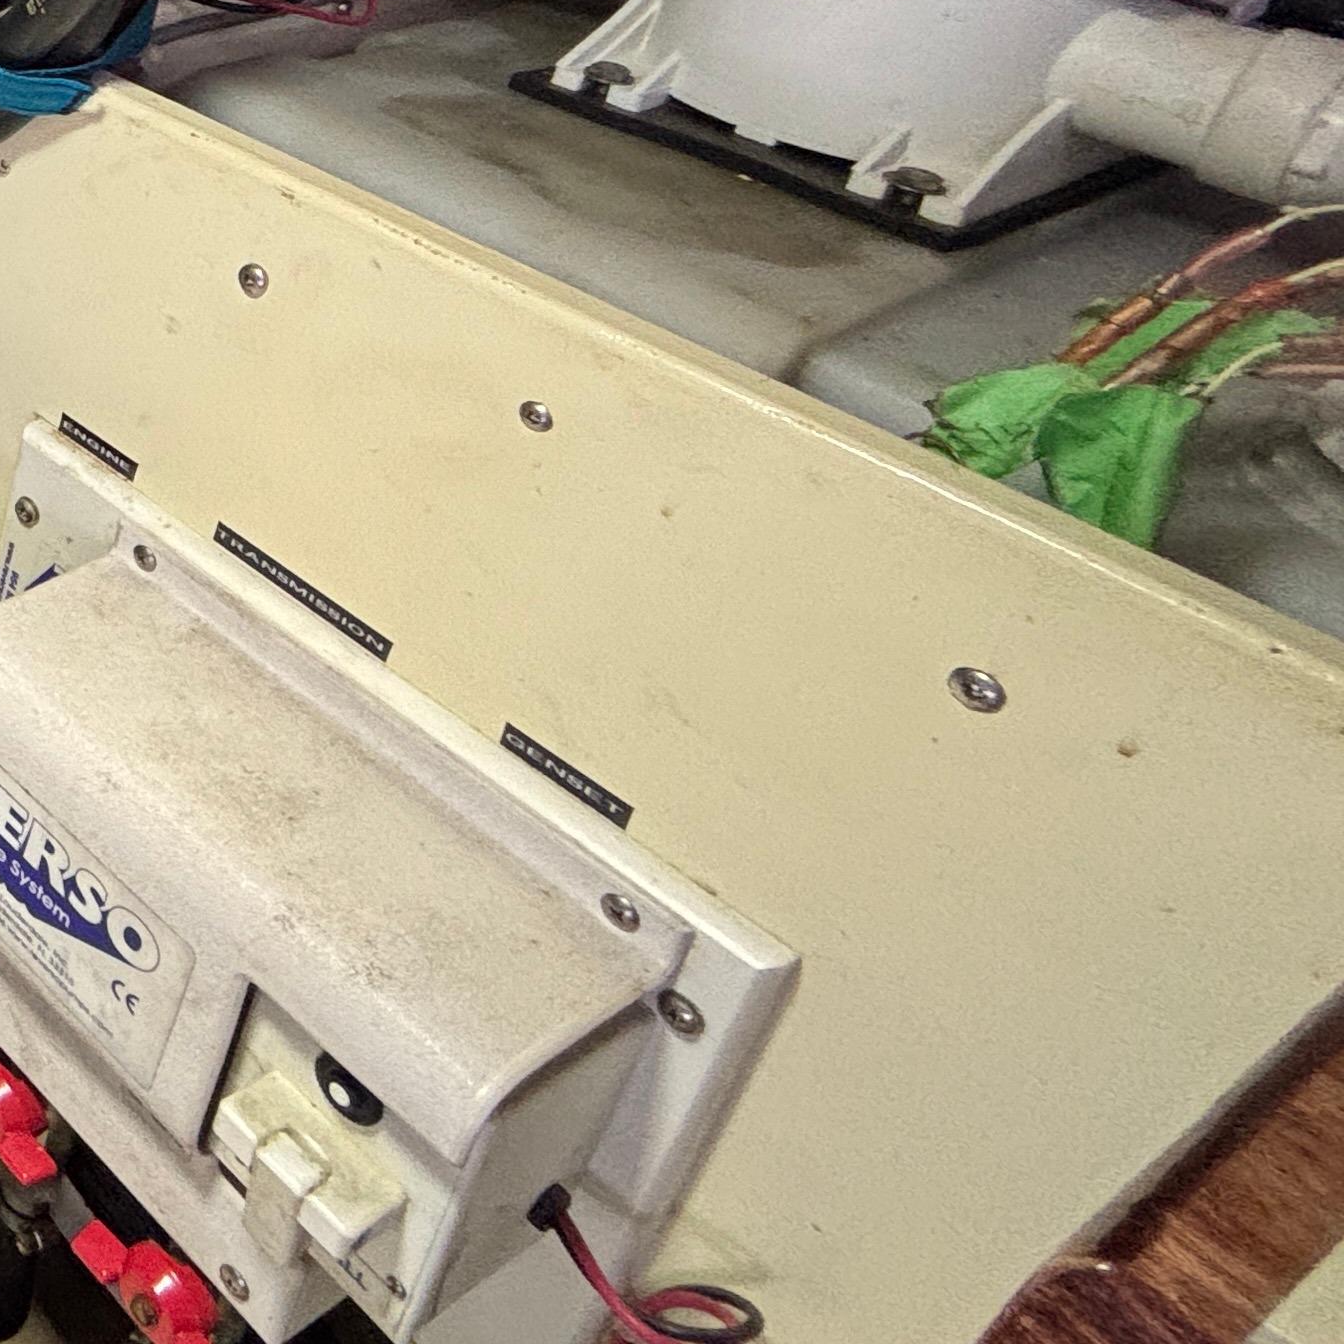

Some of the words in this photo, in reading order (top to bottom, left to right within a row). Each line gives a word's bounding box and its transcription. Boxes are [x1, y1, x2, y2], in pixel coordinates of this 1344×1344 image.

[61, 419, 133, 473] ENGINE
[218, 528, 385, 653] TRANSMISSION
[505, 733, 624, 815] GENSET
[8, 859, 72, 929] System
